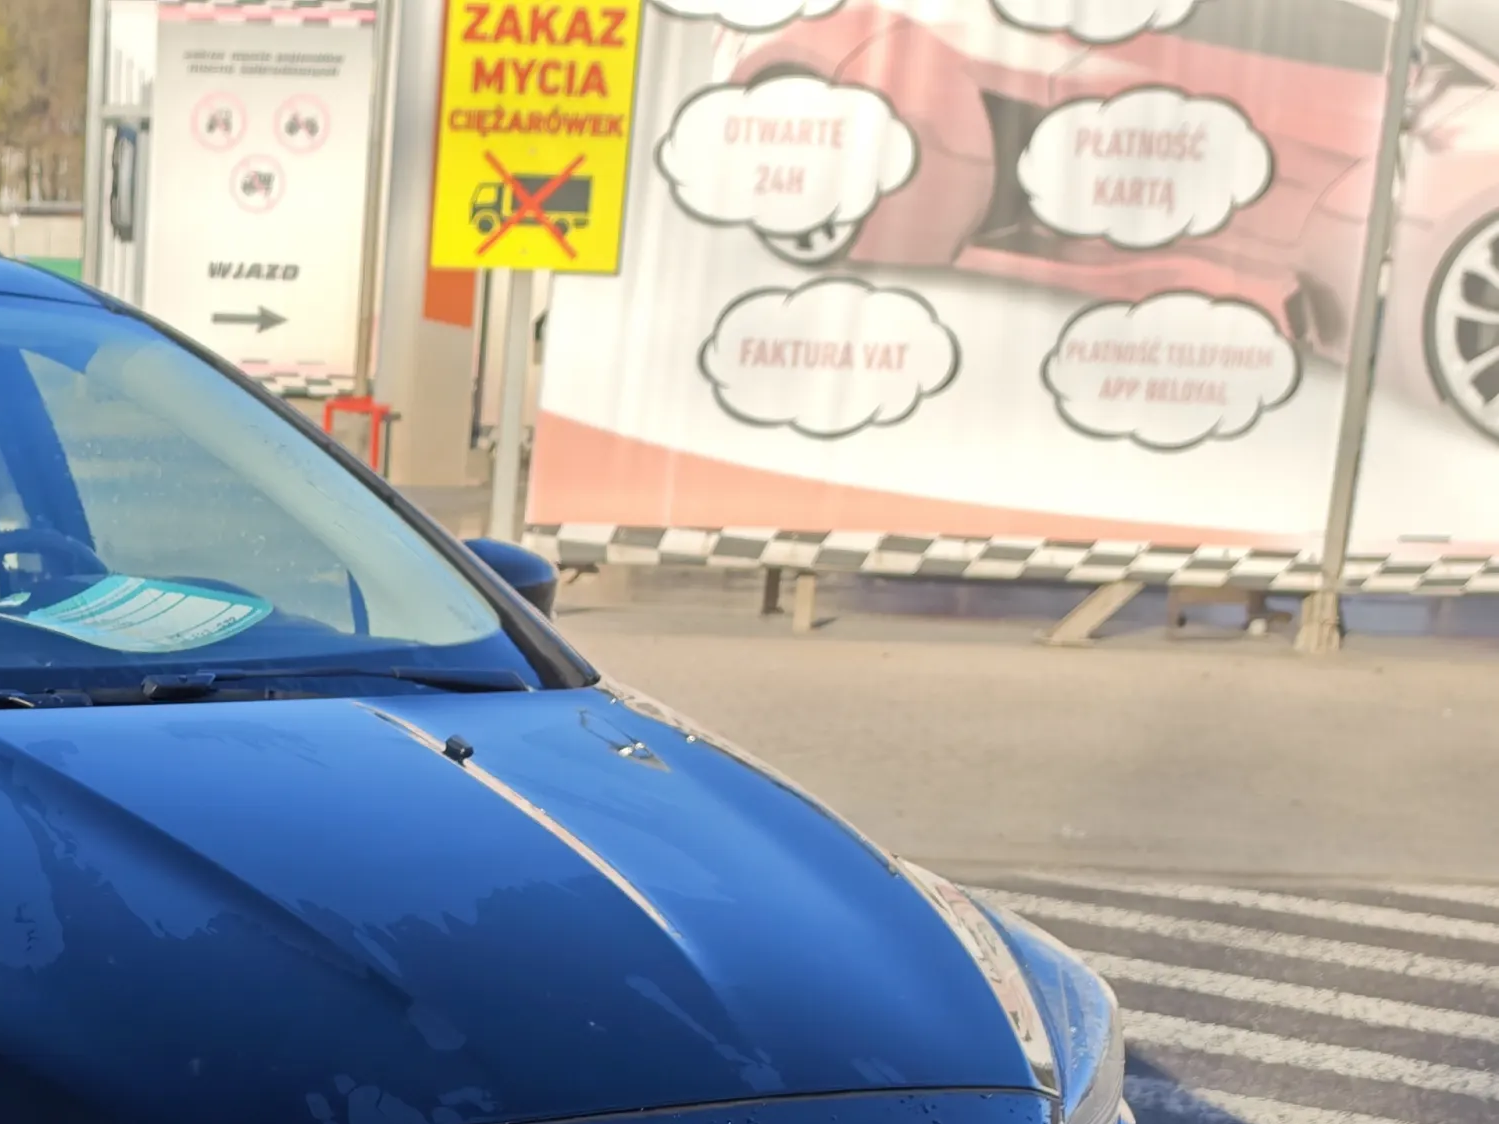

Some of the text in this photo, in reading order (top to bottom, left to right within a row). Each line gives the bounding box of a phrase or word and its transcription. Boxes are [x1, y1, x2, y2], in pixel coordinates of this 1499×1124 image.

[463, 4, 627, 47] ZAKAZ
[472, 57, 609, 97] MYCIA
[450, 104, 625, 138] CIĘŻARÓWEK
[724, 116, 847, 149] OTWARTE
[1074, 122, 1208, 160] PŁATNOŚĆ
[753, 163, 805, 196] 24H
[208, 260, 300, 281] WJAZD
[739, 337, 911, 371] FAKTURA VAT
